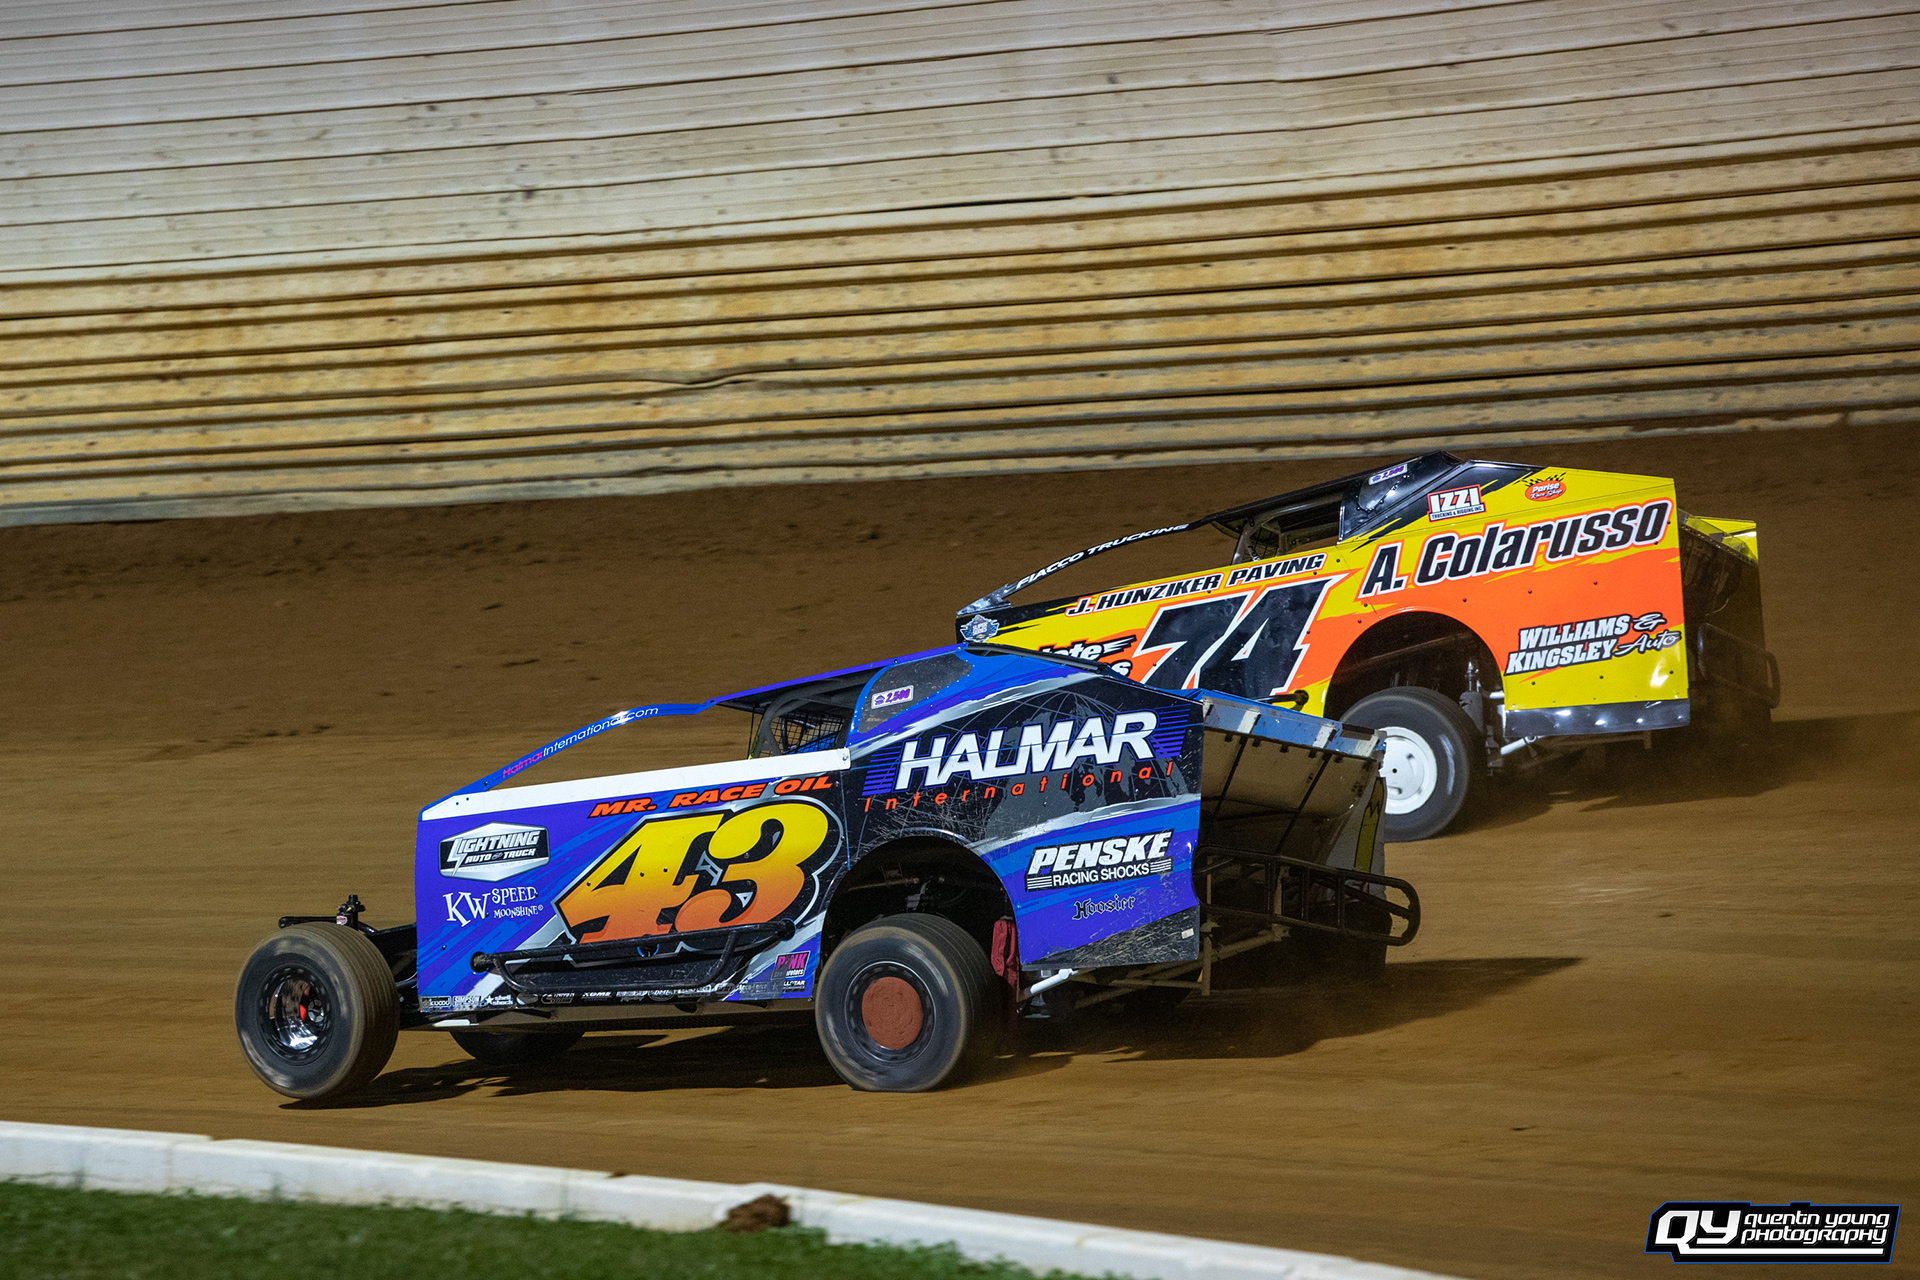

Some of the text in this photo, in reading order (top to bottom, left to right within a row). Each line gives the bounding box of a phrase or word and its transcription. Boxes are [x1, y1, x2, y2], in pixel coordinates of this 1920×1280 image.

[1430, 487, 1480, 513] IZZI
[1532, 483, 1560, 493] Parise
[1432, 511, 1453, 519] TRUCKING
[1016, 524, 1189, 589] FIACCO TRUCKING
[1363, 505, 1669, 595] A. Colarusso
[1069, 555, 1325, 615] J. HUNZIKER PAVING
[1137, 576, 1344, 695] 74
[1506, 630, 1680, 674] KINGSLEY Auto
[1520, 613, 1666, 650] WILLIAMS &
[895, 710, 1158, 792] HALMAR
[590, 776, 833, 817] MR. RACE OIL
[864, 762, 1173, 812] International
[447, 831, 540, 874] LIGHTNING
[465, 853, 492, 864] AUTO
[503, 848, 536, 859] TRUCK
[558, 802, 830, 944] 43
[1027, 831, 1172, 875] PENSKE
[1053, 862, 1150, 887] RACING SHOCKS
[443, 886, 537, 927] KW SPEED
[1072, 894, 1136, 920] Hoosier
